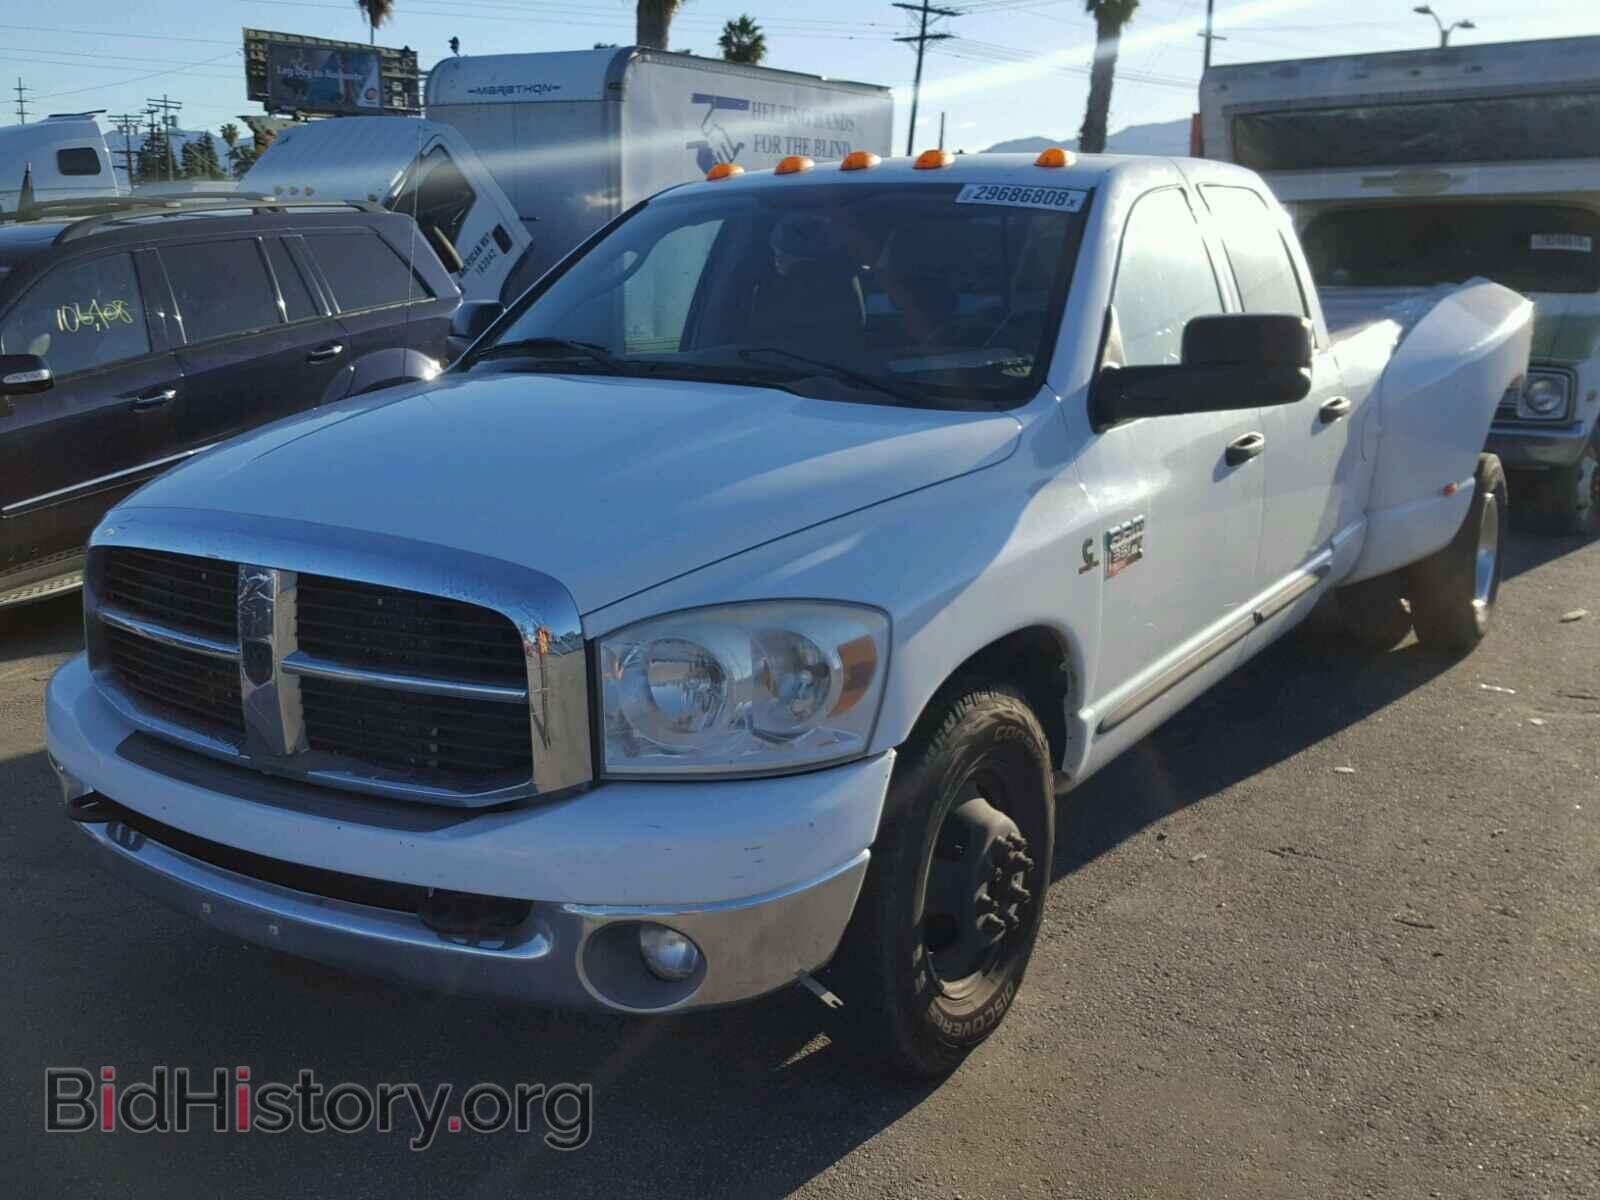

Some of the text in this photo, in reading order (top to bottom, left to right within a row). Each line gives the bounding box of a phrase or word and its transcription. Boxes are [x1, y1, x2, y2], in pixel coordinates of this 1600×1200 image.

[753, 134, 850, 159] FOR THE BLIND
